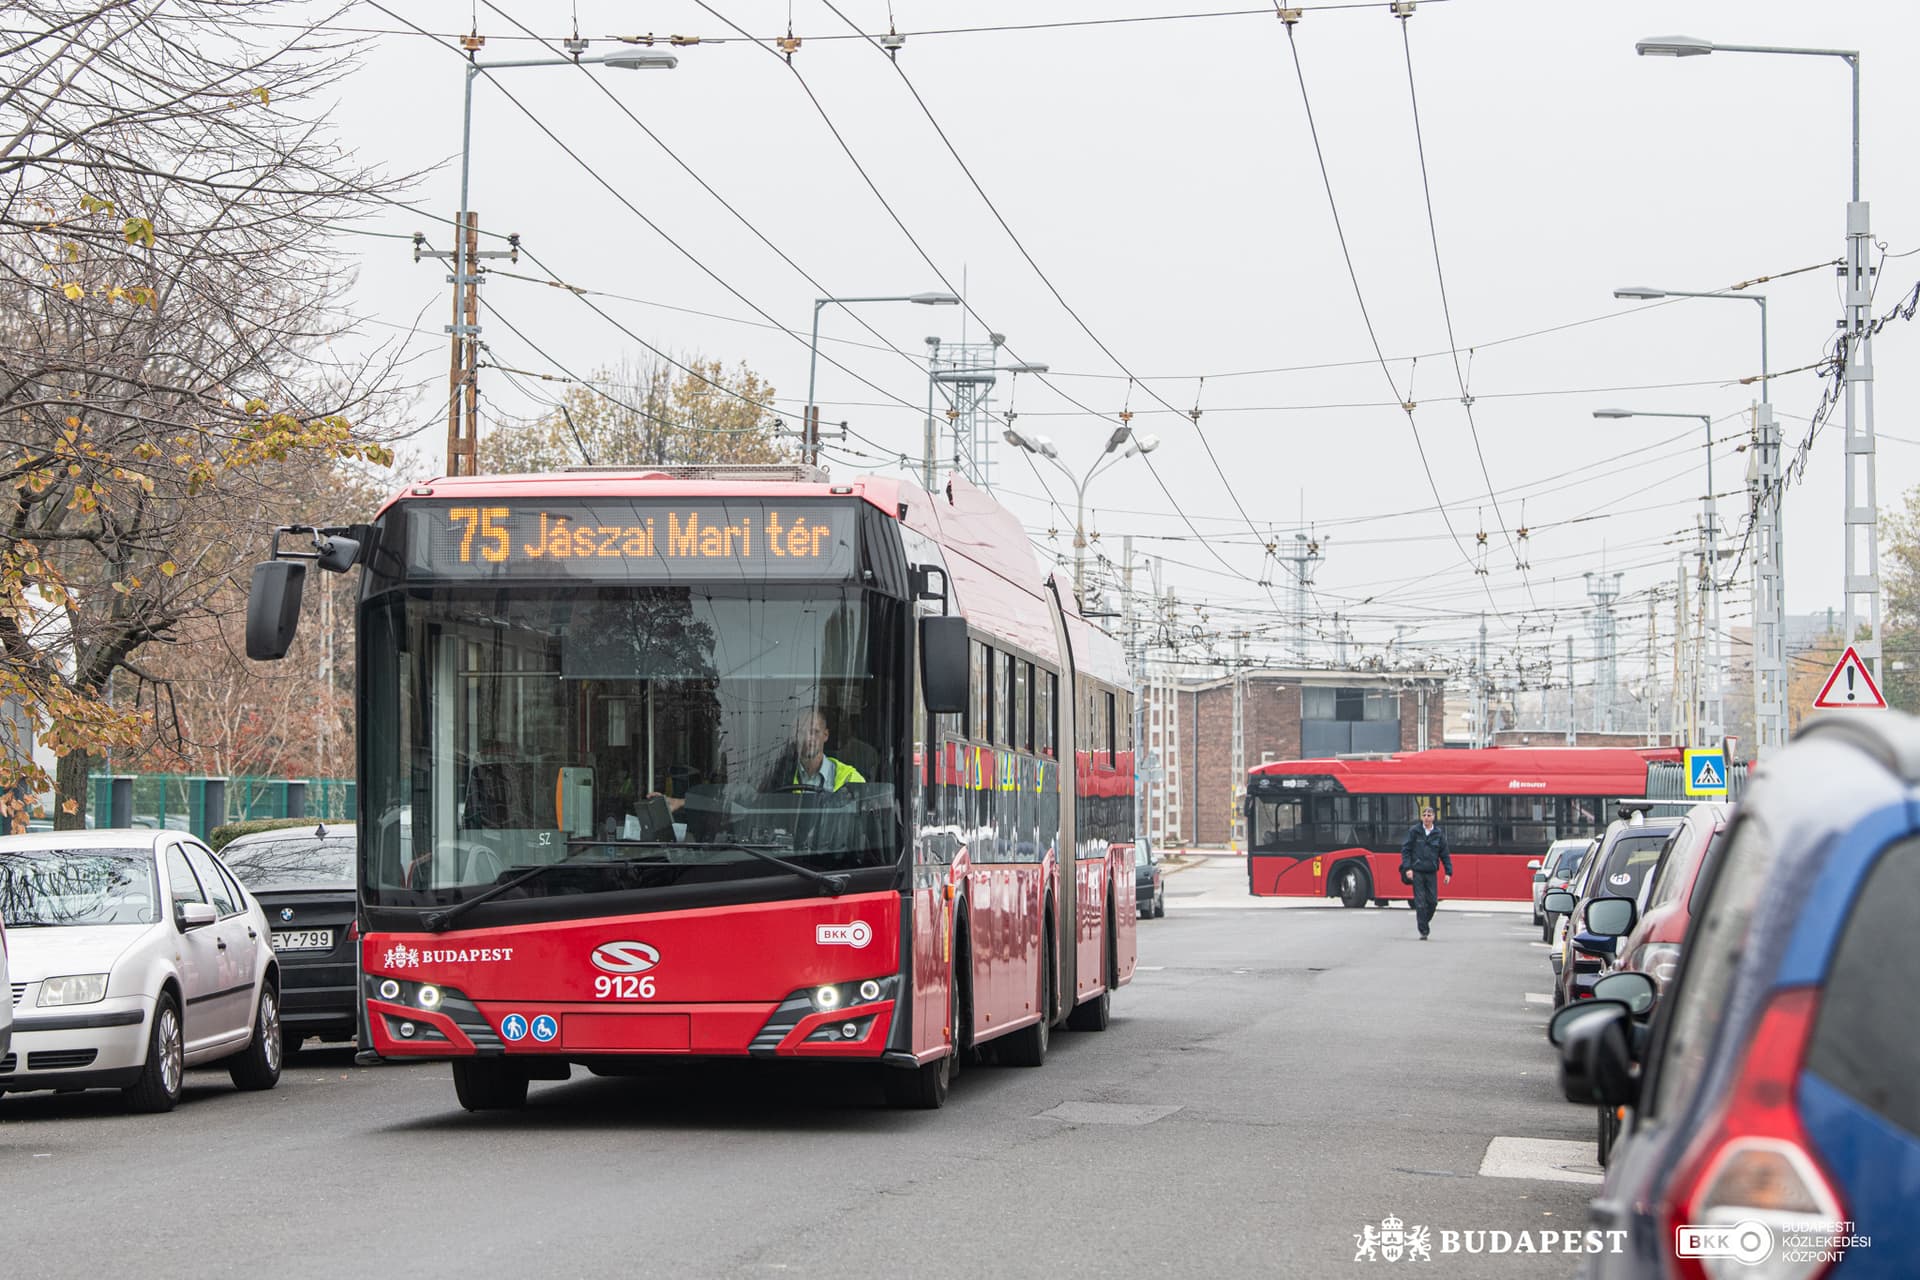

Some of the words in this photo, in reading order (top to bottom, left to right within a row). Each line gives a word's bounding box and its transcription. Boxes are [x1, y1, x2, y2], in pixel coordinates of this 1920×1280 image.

[450, 507, 510, 562] 75
[524, 512, 654, 557] Jászai
[669, 512, 750, 556] Mari
[765, 512, 830, 556] tér
[824, 930, 847, 938] BKK
[422, 947, 513, 963] BUDAPEST
[594, 976, 656, 998] 9126
